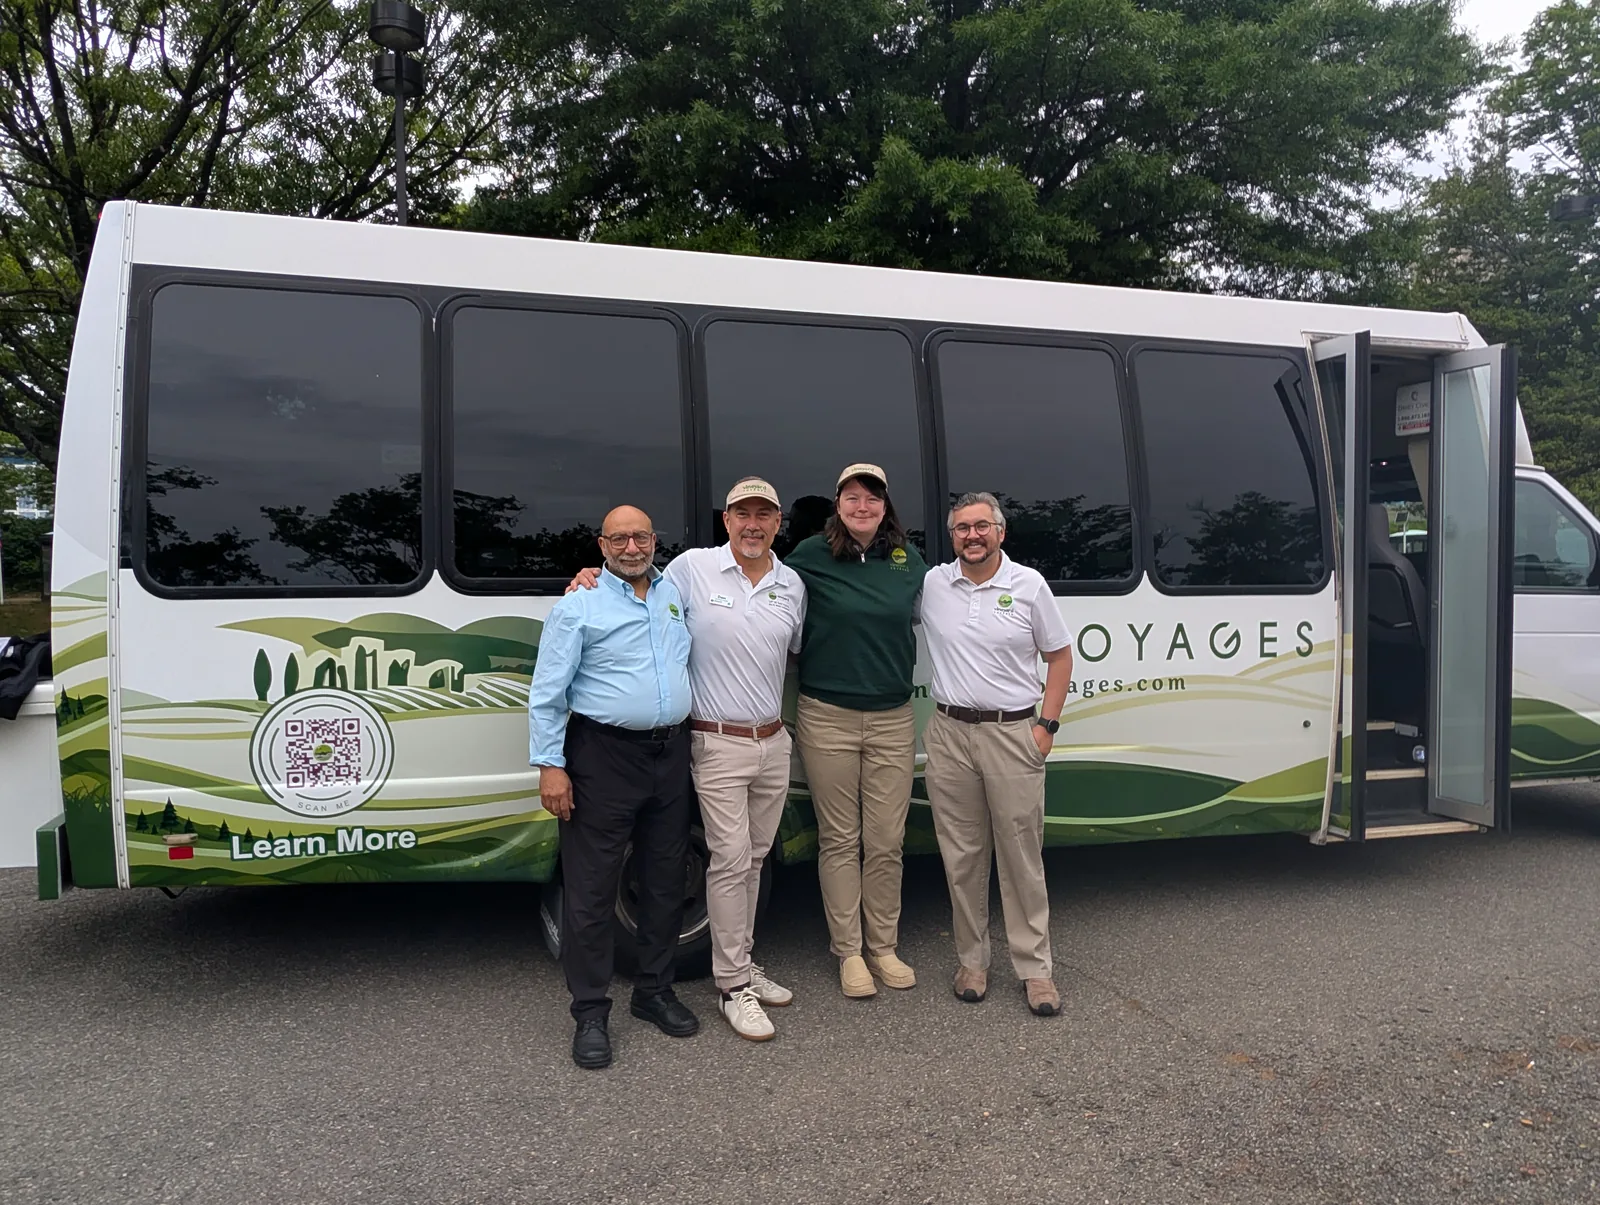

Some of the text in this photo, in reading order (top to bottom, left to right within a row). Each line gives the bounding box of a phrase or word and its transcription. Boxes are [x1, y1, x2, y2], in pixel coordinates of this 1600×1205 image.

[1040, 620, 1314, 663] OYAGES
[297, 799, 350, 812] SCAN ME
[231, 827, 416, 860] Learn More
